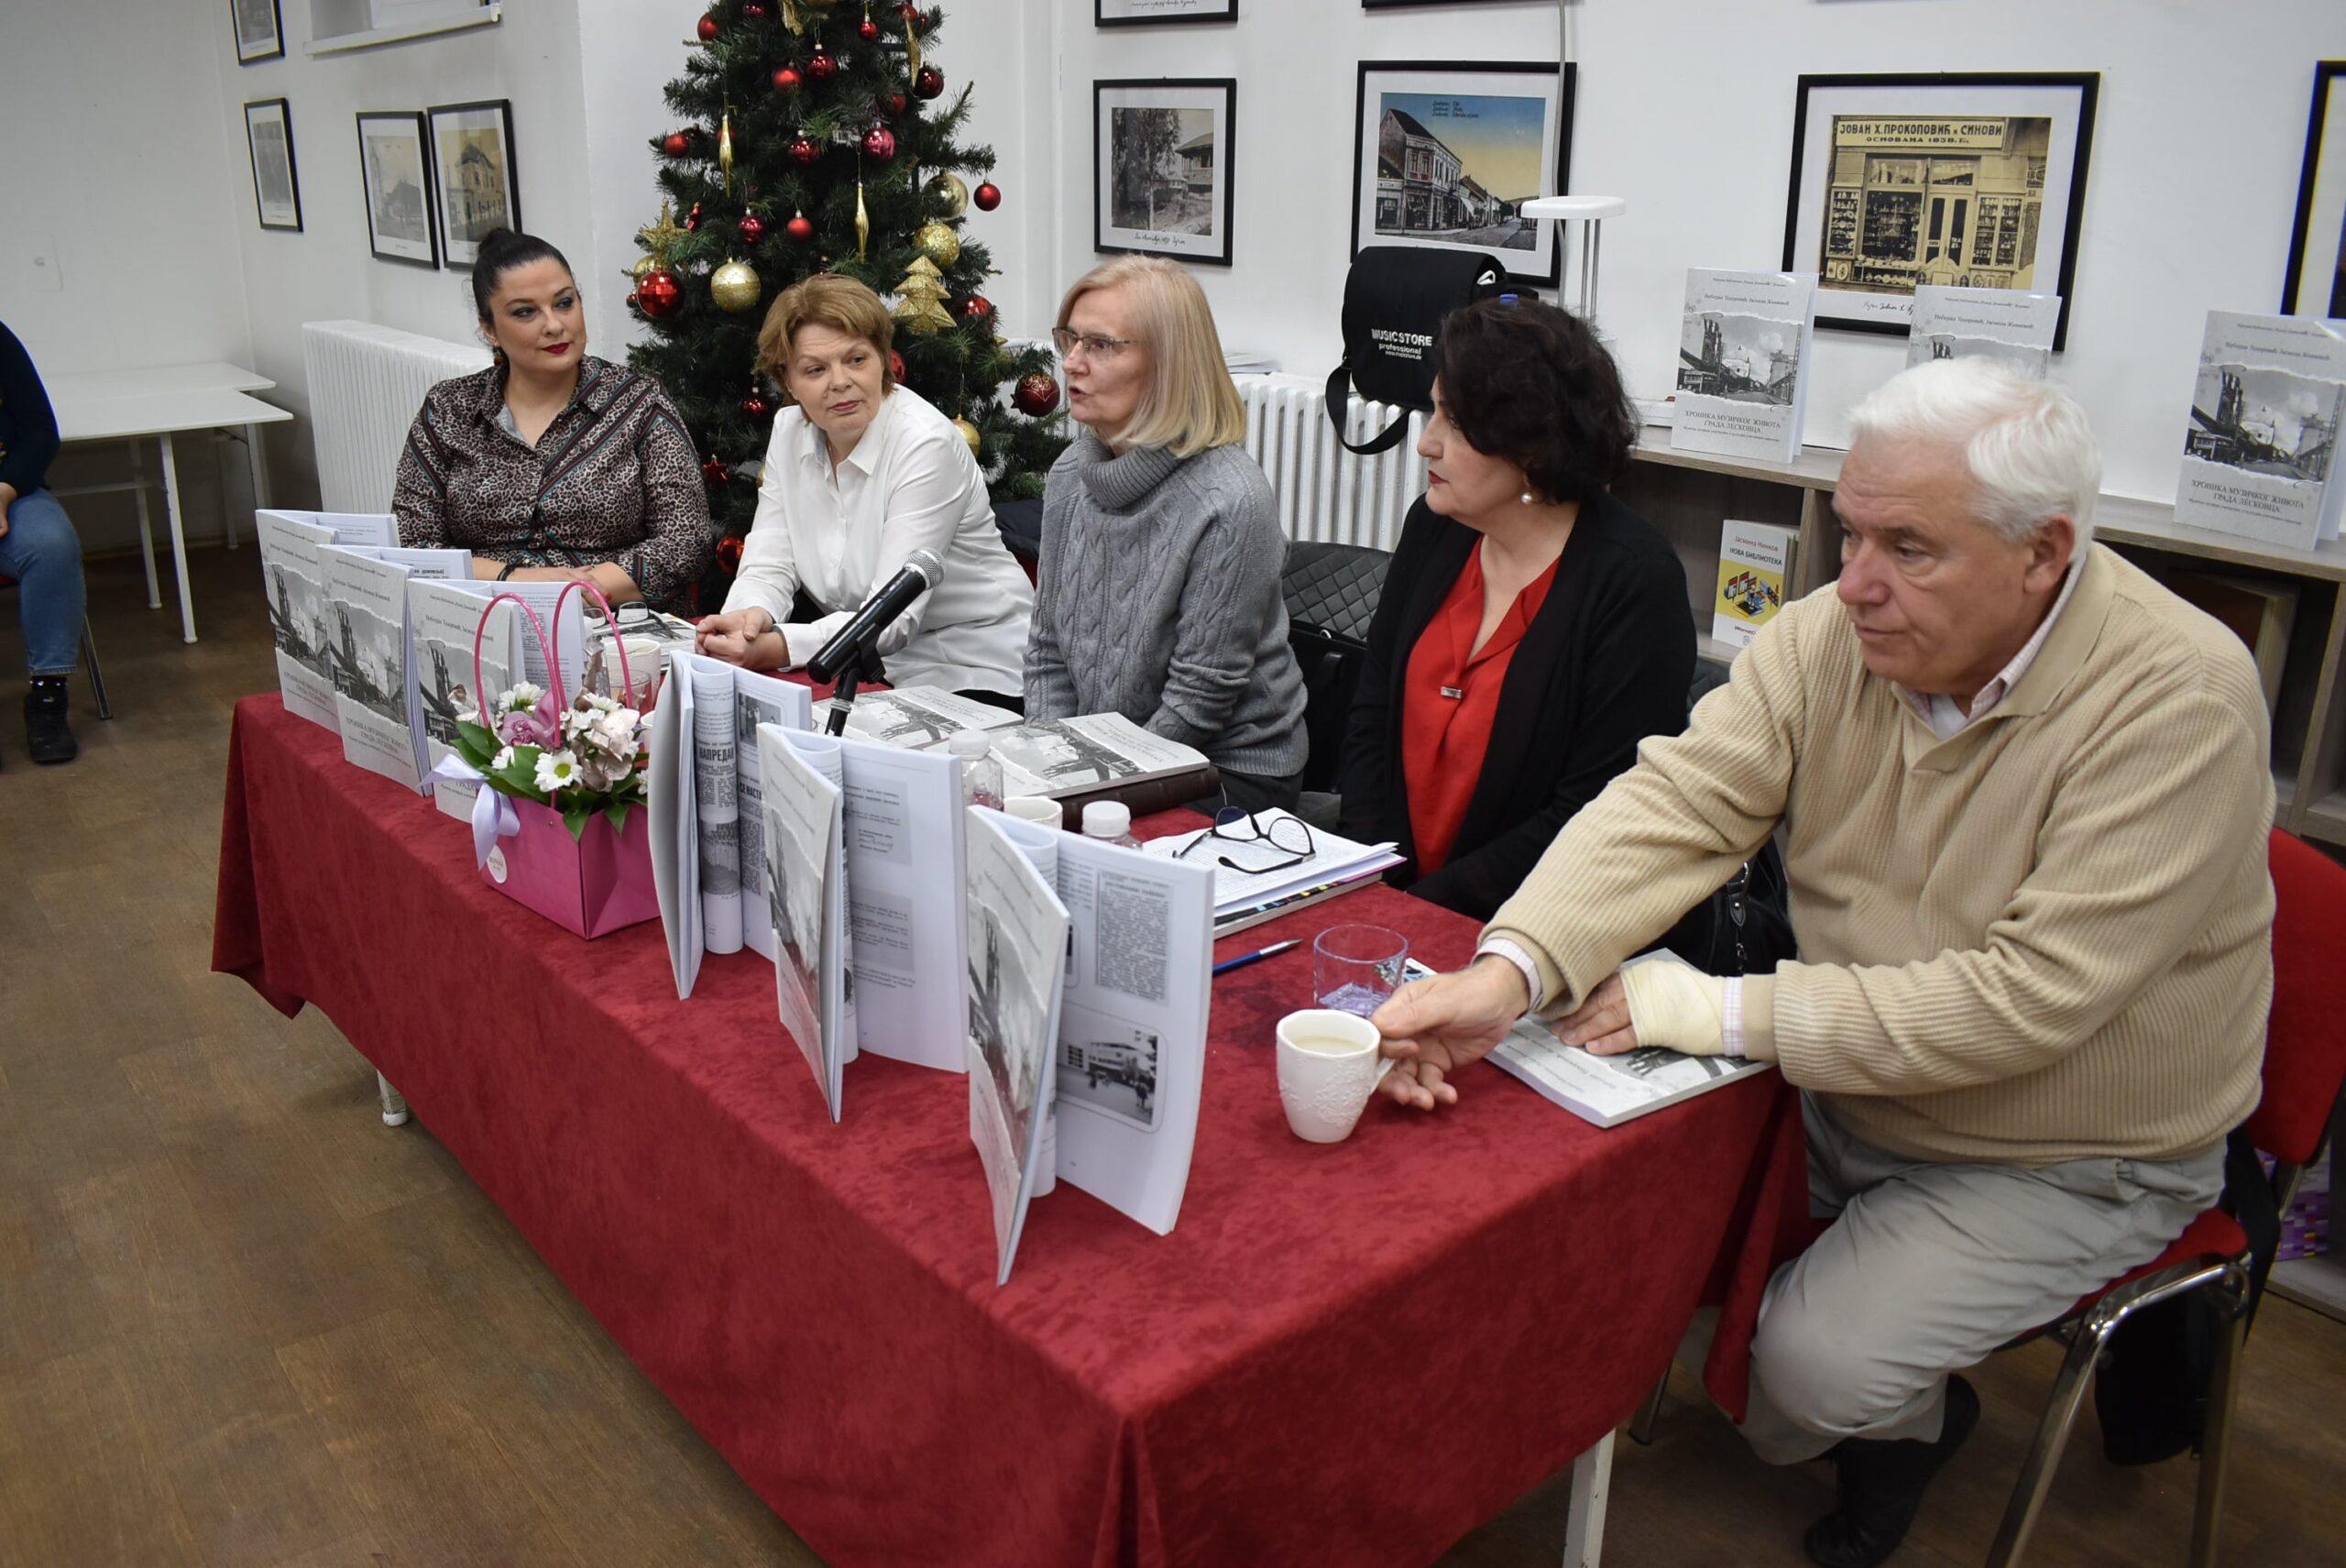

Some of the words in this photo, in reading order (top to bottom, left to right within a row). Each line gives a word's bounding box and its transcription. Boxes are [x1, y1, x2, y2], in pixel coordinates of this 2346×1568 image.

[1840, 124, 1871, 135] ЈОВАН
[1960, 125, 2002, 136] СИНОВИ
[1729, 547, 1745, 557] НОВА
[1745, 552, 1782, 566] БИБЛИОТЕКА
